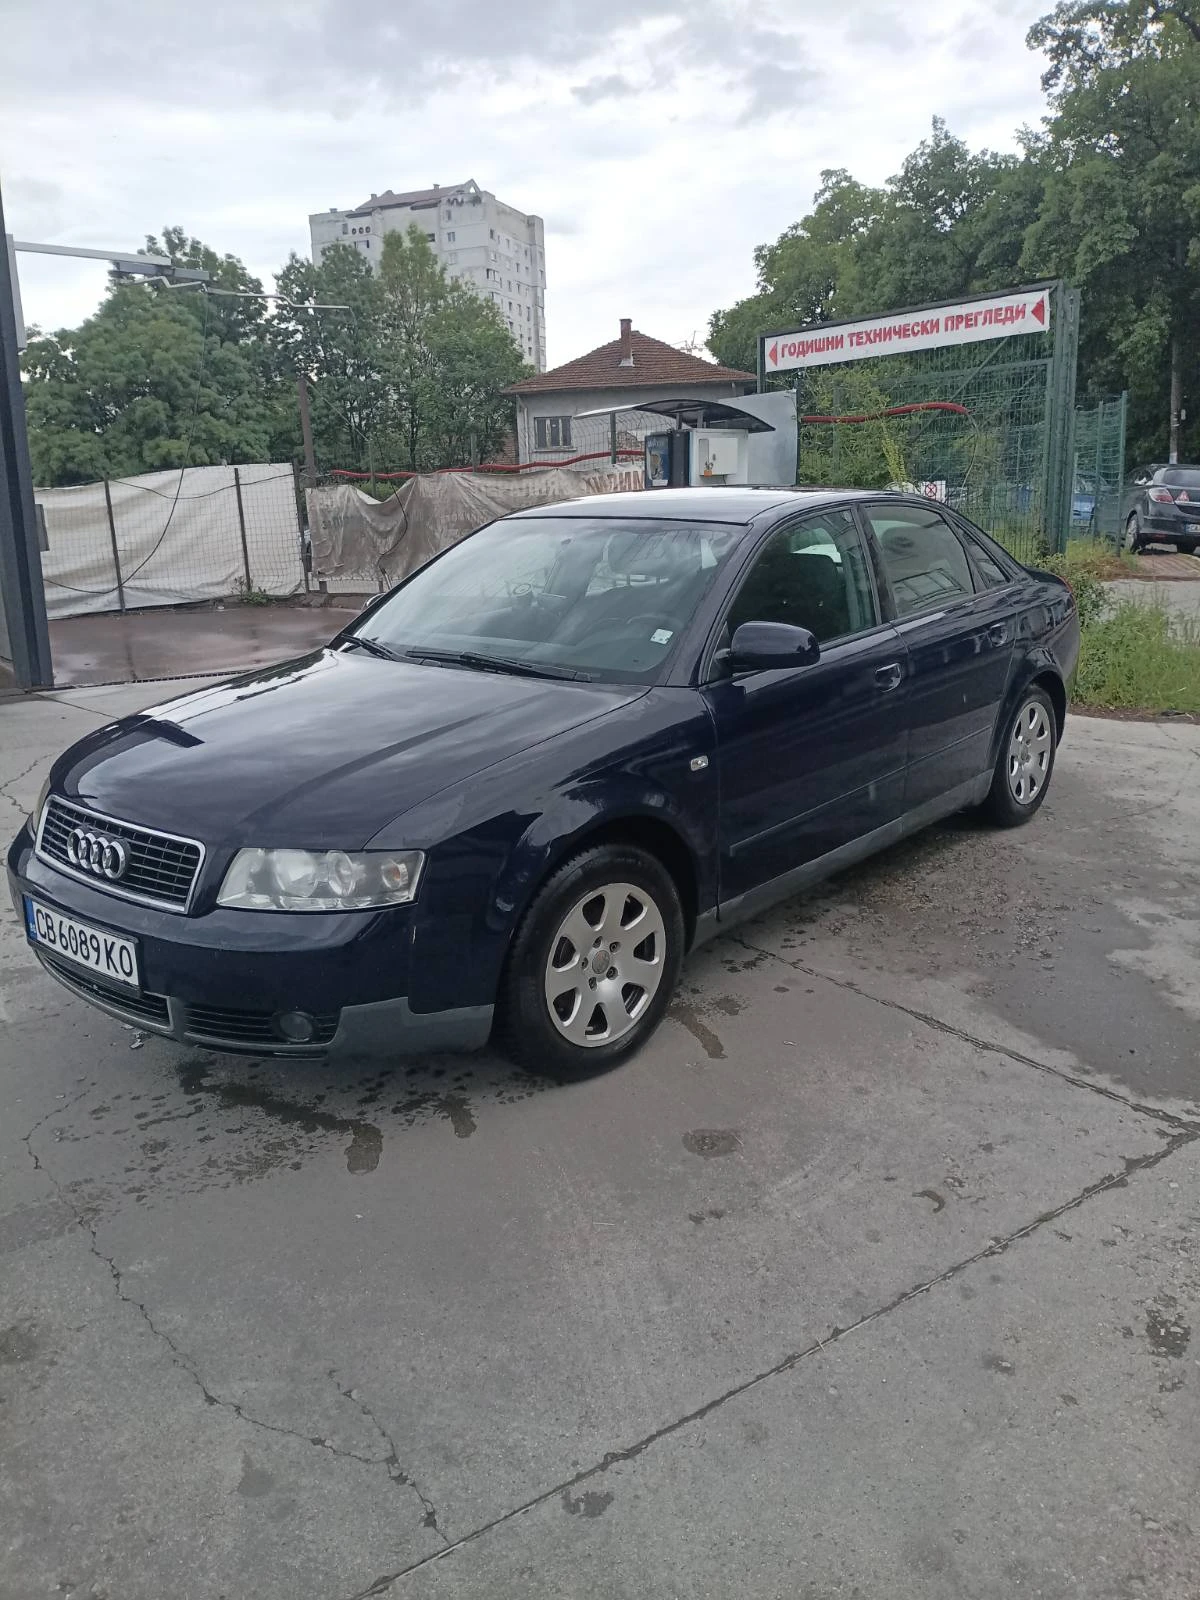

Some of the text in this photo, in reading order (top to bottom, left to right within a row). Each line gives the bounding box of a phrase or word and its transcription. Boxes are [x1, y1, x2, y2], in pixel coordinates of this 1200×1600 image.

[781, 303, 1027, 359] ГОДИШНИ ТЕХНИЧЕСКИ ПРЕГЛЕДИ
